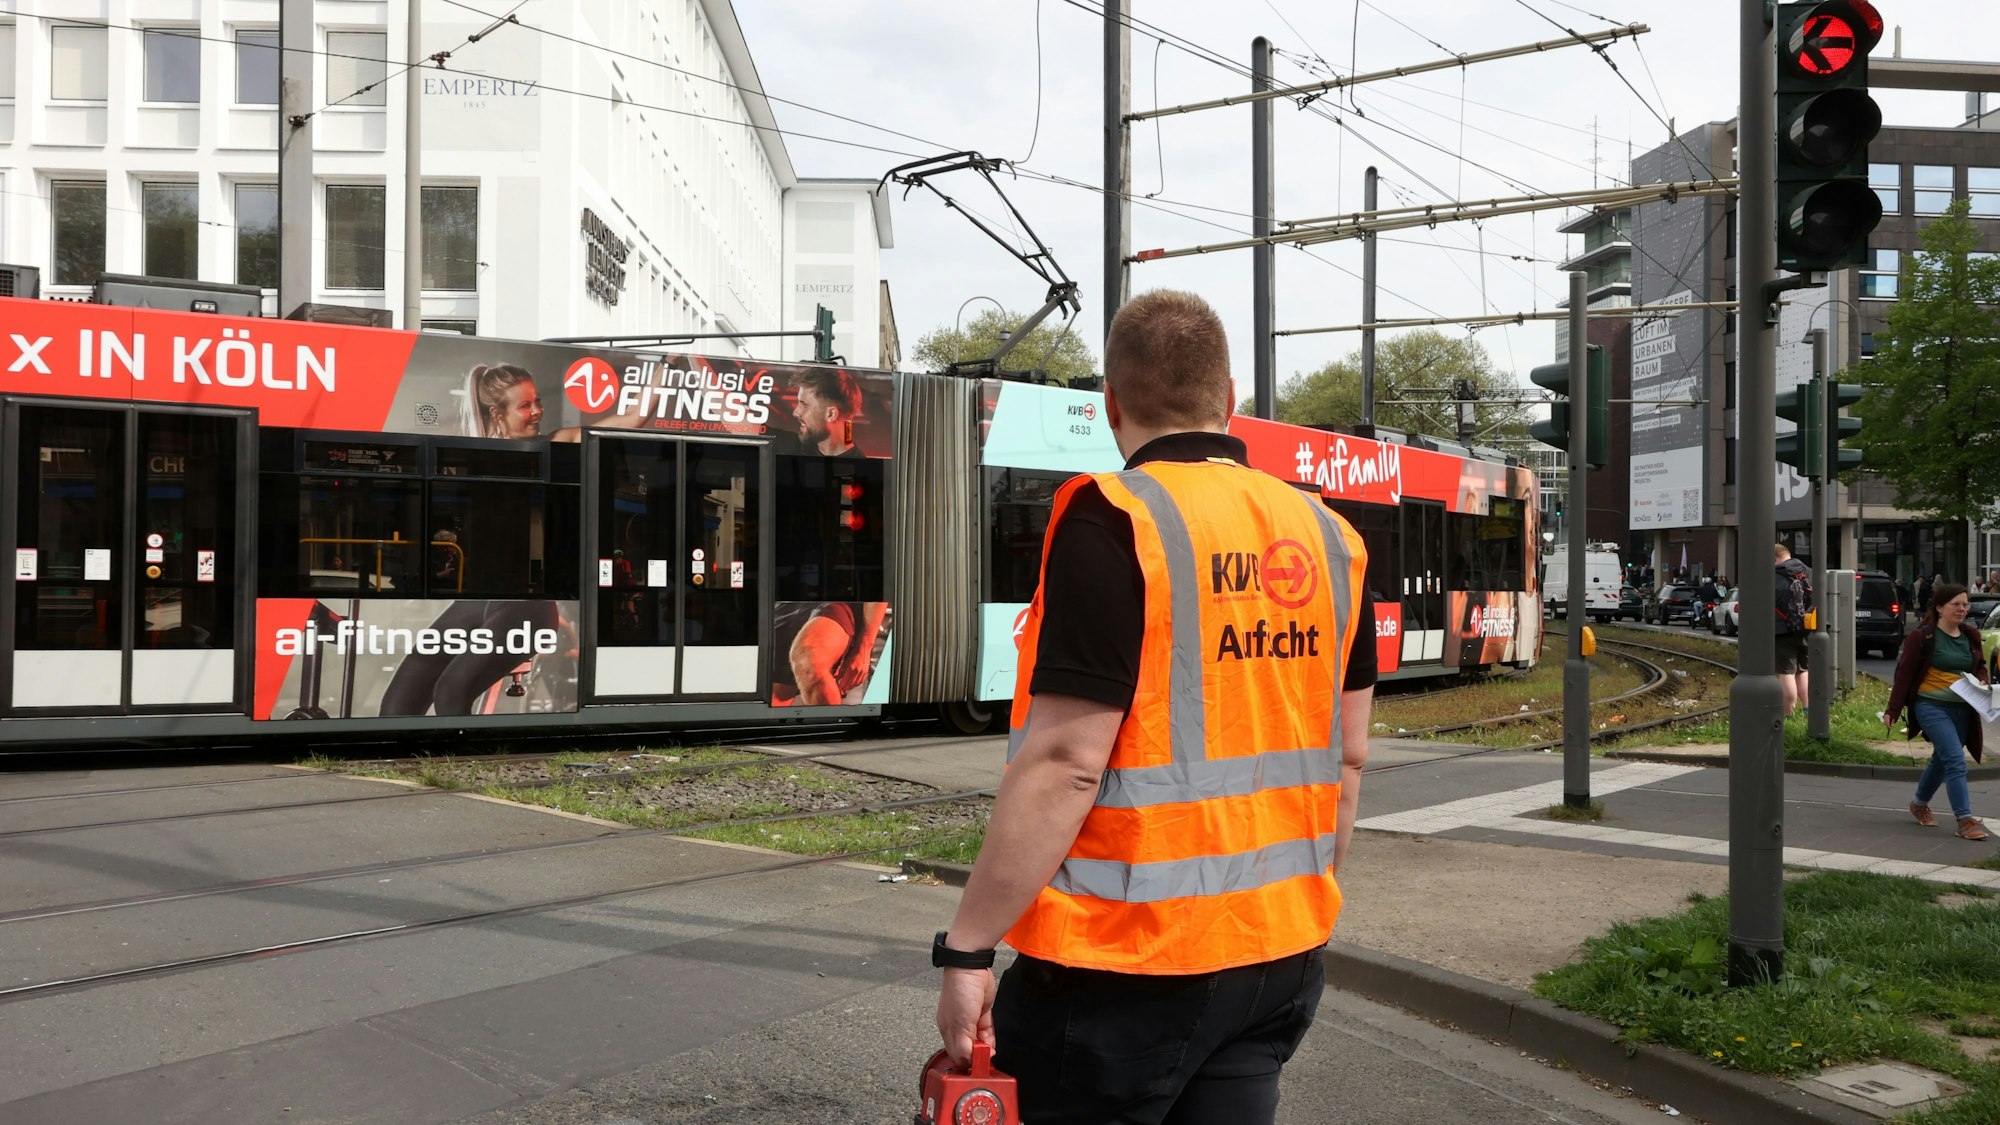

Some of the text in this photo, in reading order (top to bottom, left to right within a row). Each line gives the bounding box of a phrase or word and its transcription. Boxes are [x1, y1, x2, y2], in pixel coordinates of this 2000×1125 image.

[424, 78, 538, 97] EMPERTZ
[463, 101, 487, 109] 1845
[796, 284, 854, 293] LEMPERTZ
[1635, 321, 1667, 341] LUFT IM
[1635, 339, 1673, 359] URBANEN
[79, 329, 145, 381] IN
[173, 328, 336, 393] KÖLN
[1635, 361, 1659, 378] RAUM
[623, 361, 655, 386] all
[616, 385, 772, 424] FITNESS
[1067, 405, 1084, 416] KVB
[689, 421, 707, 431] DEN
[1069, 425, 1091, 435] 4533
[1295, 437, 1402, 503] #aifamily
[275, 620, 558, 655] ai-fitness.de
[1481, 619, 1515, 638] FITNESS
